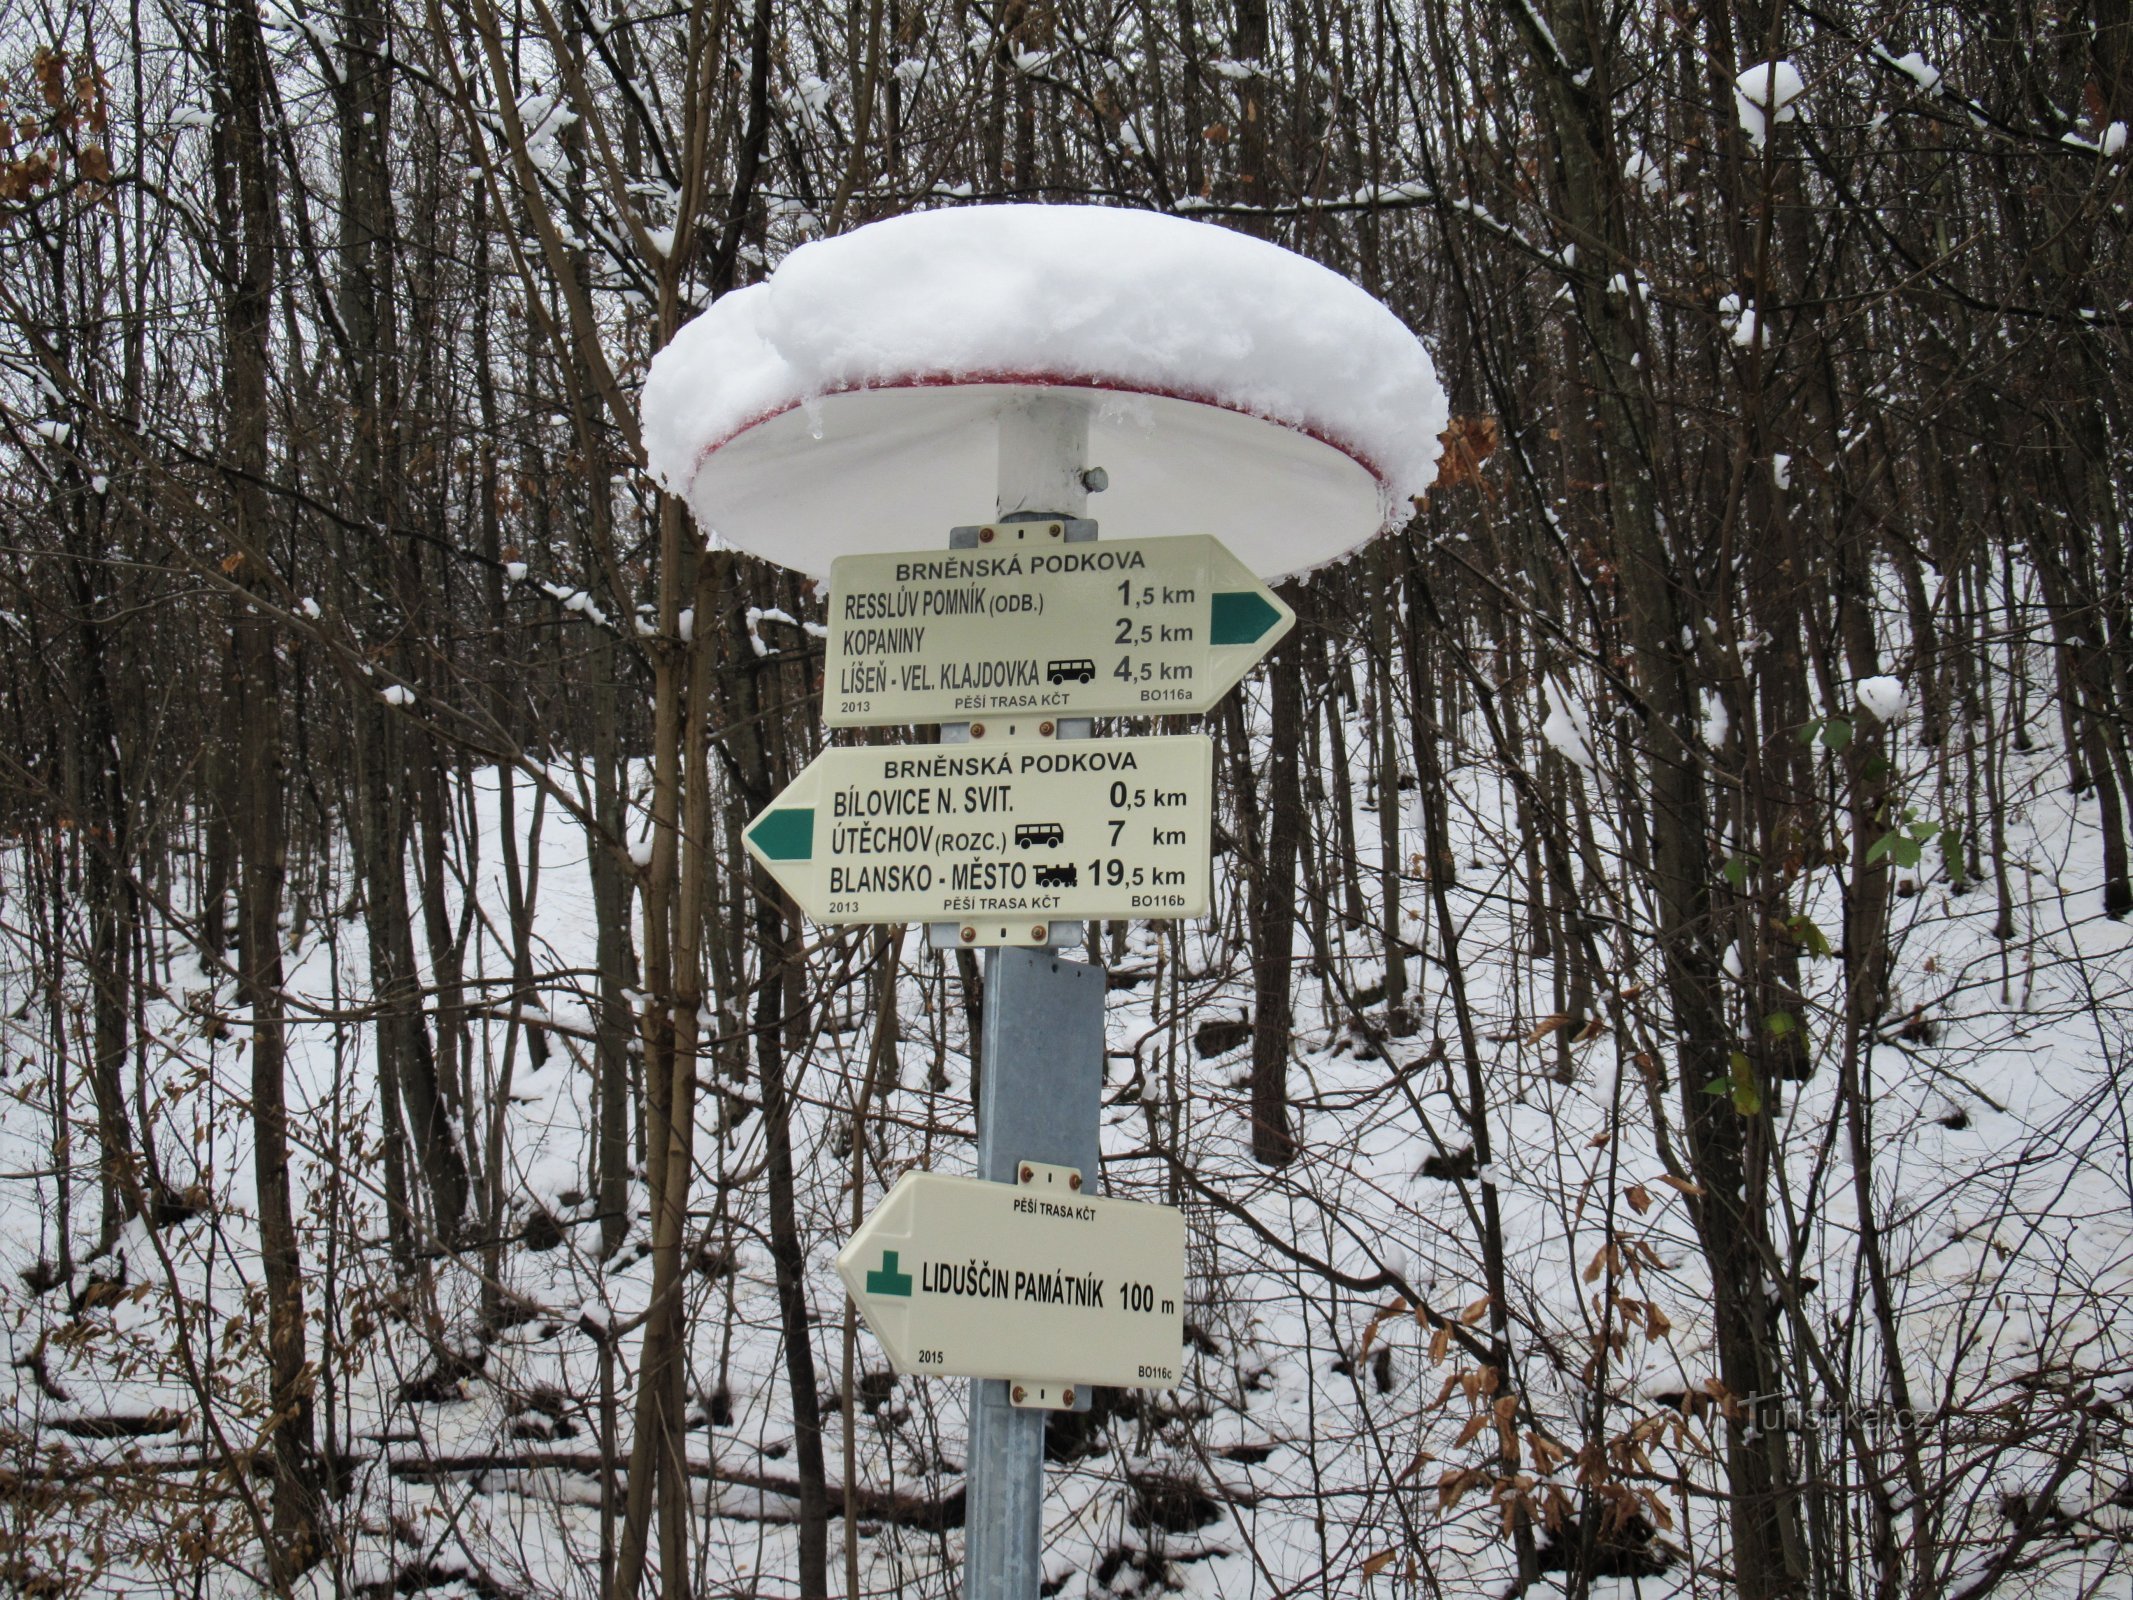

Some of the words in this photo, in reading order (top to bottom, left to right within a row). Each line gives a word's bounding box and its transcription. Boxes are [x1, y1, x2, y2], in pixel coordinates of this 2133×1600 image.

[896, 554, 1023, 582] BRNĚNSKÁ
[1030, 550, 1145, 574] PODKOVA
[845, 584, 919, 620] RESSLŮV
[922, 582, 986, 616] POMNÍK
[989, 593, 1044, 618] (ODB.)
[1117, 579, 1155, 609] 1,5
[1162, 586, 1195, 605] km
[843, 626, 925, 656] KOPANINY
[1114, 617, 1153, 646] 2,5
[1160, 624, 1193, 642] km
[841, 660, 887, 694] LÍŠEŇ
[901, 664, 935, 691] VEL.
[940, 659, 1040, 690] KLAJDOVKA
[1113, 655, 1152, 684] 4,5
[1160, 661, 1193, 680] km
[841, 700, 871, 713] 2013
[955, 695, 986, 709] PĚŠÍ
[990, 695, 1038, 708] TRASA
[1041, 691, 1070, 706] KČT
[1140, 688, 1193, 702] BO116a
[884, 752, 1013, 779] BRNĚNSKÁ
[1021, 751, 1138, 774] PODKOVA
[834, 785, 931, 818] BÍLOVICE
[937, 787, 957, 814] N.
[964, 785, 1013, 814] SVIT.
[1109, 780, 1146, 811] 0,5
[1154, 788, 1187, 807] km
[832, 821, 934, 855] ÚTĚCHOV
[935, 831, 1007, 855] (ROZC.)
[1108, 820, 1126, 847] 7
[1153, 827, 1186, 846] km
[830, 864, 932, 894] BLANSKO
[952, 856, 1027, 891] MĚSTO
[1088, 858, 1144, 889] 19,5
[1152, 866, 1185, 886] km
[829, 901, 859, 914] 2013
[943, 897, 975, 911] PĚŠÍ
[979, 897, 1028, 910] TRASA
[1031, 896, 1061, 909] KČT
[1131, 894, 1185, 907] BO116b
[1013, 1197, 1037, 1214] PĚŠÍ
[1039, 1202, 1074, 1219] TRASA
[1075, 1206, 1096, 1222] KČT
[922, 1259, 1009, 1299] LIDUŠČIN
[1014, 1268, 1104, 1308] PAMÁTNÍK
[1119, 1282, 1154, 1313] 100
[1161, 1300, 1174, 1315] m
[918, 1349, 944, 1364] 2015
[1138, 1365, 1172, 1380] BO116c
